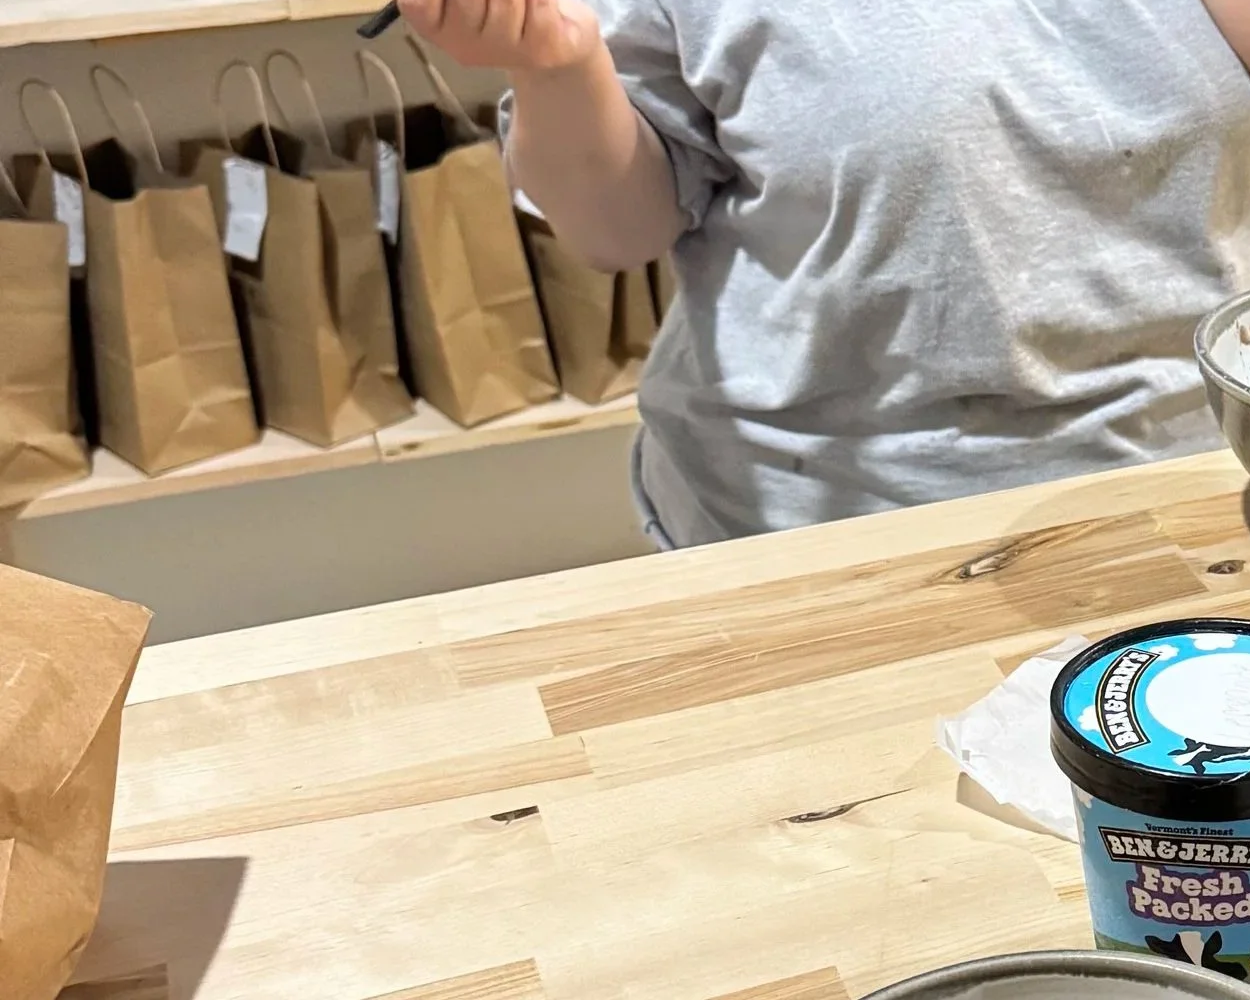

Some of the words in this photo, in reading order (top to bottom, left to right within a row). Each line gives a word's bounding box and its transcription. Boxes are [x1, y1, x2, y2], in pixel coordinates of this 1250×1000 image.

[1144, 823, 1199, 835] Vermont's
[1200, 826, 1234, 836] Finest
[1141, 865, 1244, 897] Fresh
